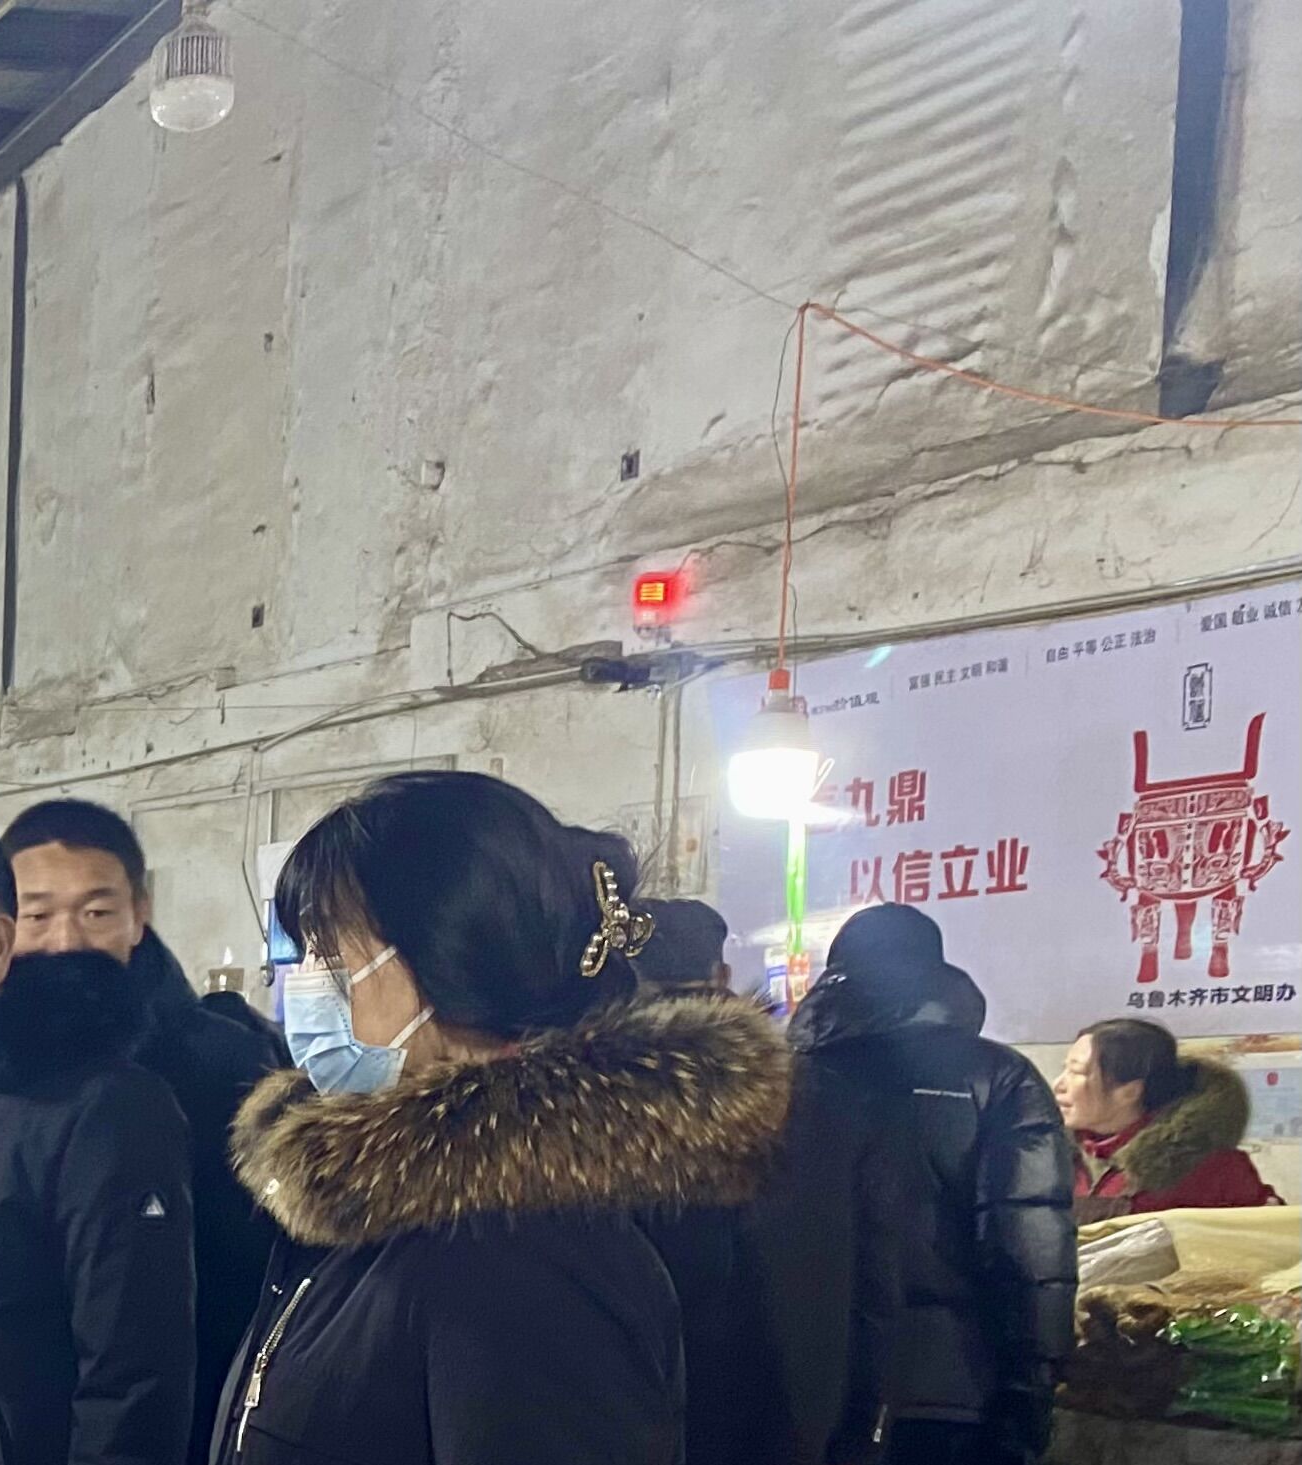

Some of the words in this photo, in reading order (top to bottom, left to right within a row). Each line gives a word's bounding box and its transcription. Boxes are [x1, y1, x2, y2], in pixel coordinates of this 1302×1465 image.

[959, 662, 984, 682] 文明
[1100, 632, 1128, 653] 公正
[1130, 627, 1157, 648] 法治
[1263, 599, 1293, 621] 诚信
[849, 837, 1030, 905] 以信立业
[1126, 983, 1297, 1010] 乌鲁木齐市文明办
